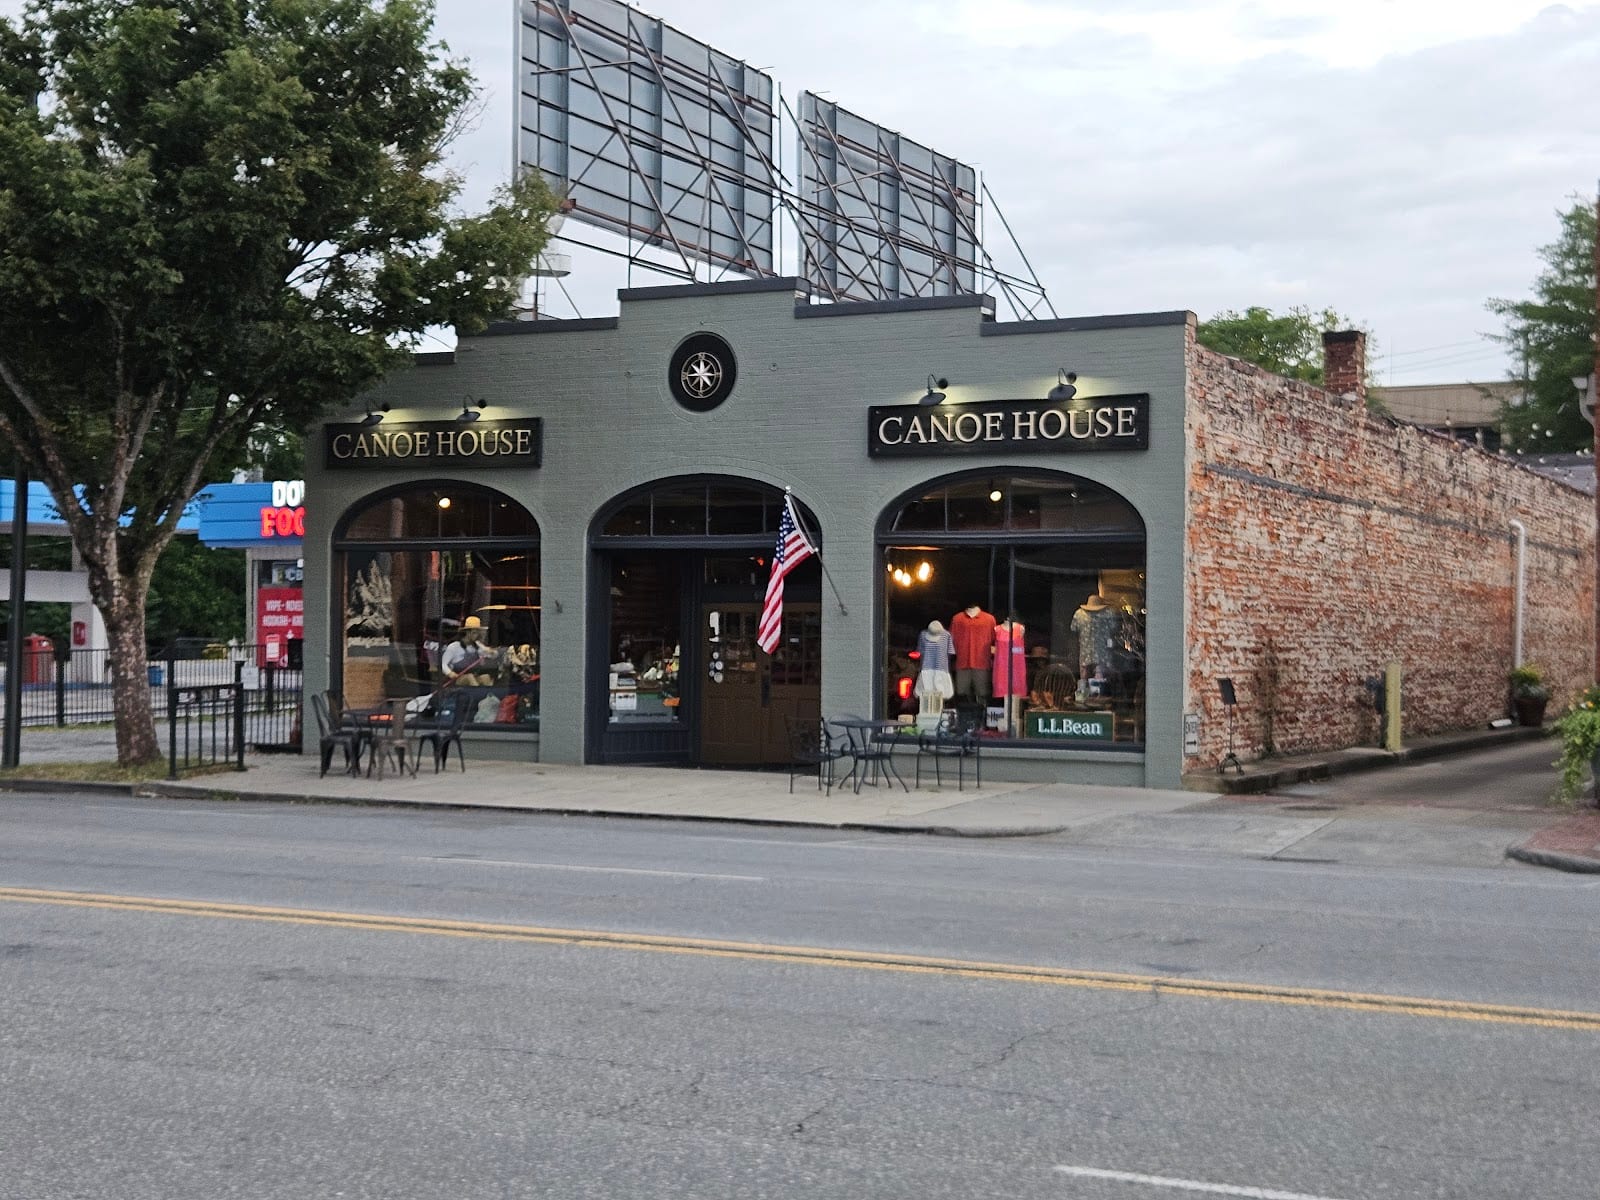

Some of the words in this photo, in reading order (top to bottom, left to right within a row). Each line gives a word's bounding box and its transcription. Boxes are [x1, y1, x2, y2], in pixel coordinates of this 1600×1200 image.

[878, 412, 1004, 445] CANOE
[1011, 407, 1137, 440] HOUSE
[332, 431, 430, 459] CANOE
[435, 429, 532, 456] HOUSE
[272, 480, 304, 507] DO
[1037, 717, 1104, 736] L.L.Bean
